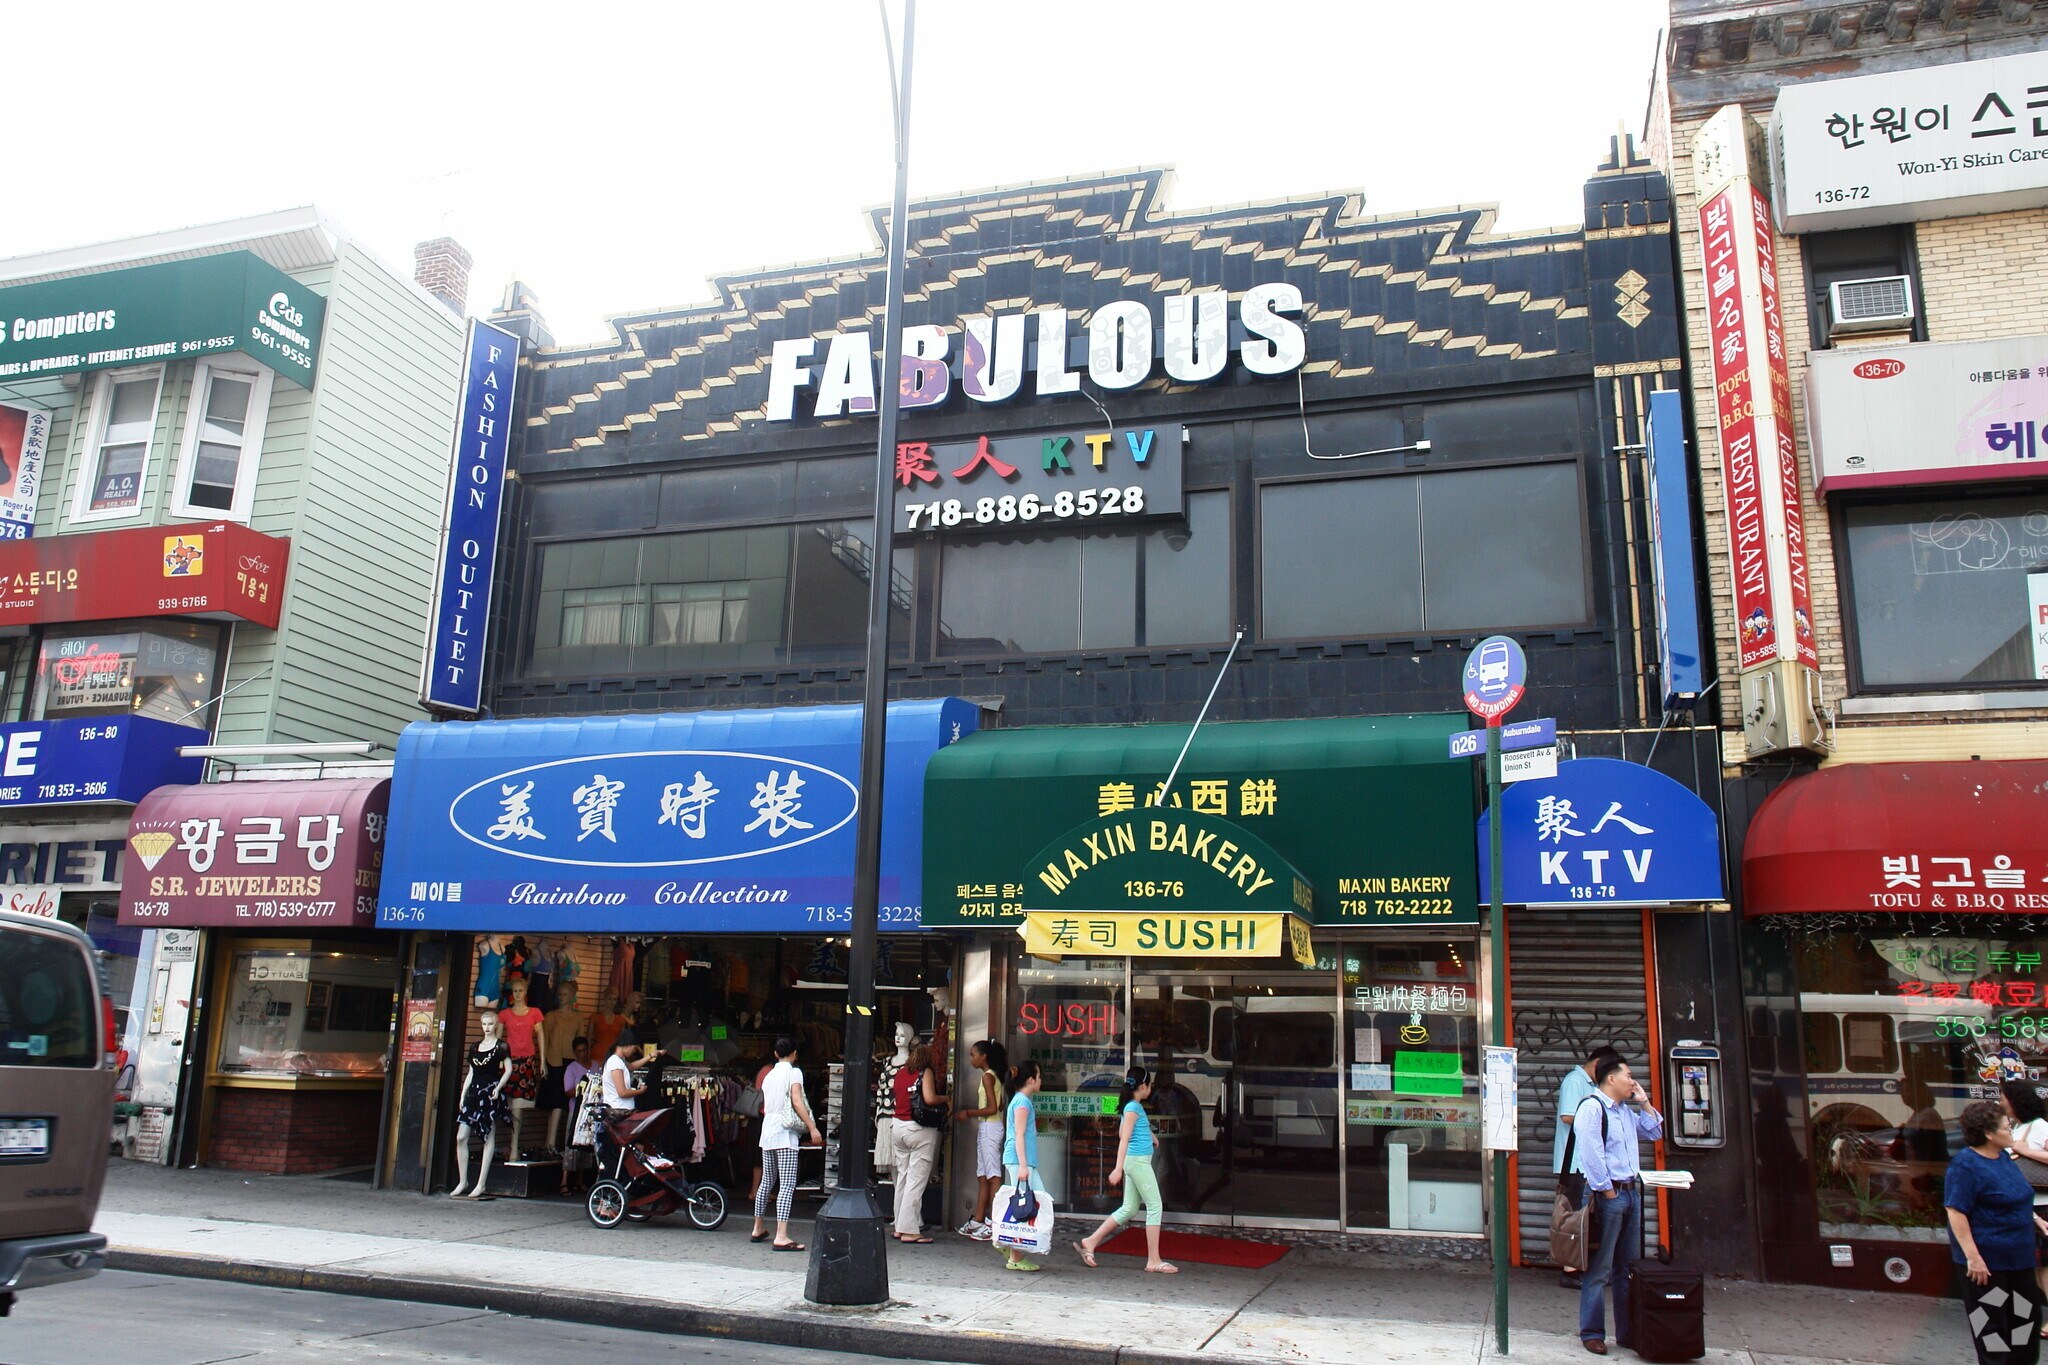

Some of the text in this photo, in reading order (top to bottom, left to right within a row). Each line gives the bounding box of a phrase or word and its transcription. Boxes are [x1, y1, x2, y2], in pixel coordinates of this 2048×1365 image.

[1825, 104, 1949, 150] 한원이
[1898, 147, 2048, 176] Won-Yi Skin Care
[1815, 186, 1870, 204] 136-72
[13, 309, 116, 342] Computers
[259, 310, 310, 350] Computers
[22, 362, 29, 373] &
[30, 354, 79, 372] UPGRADES
[88, 347, 134, 365] INTERNET
[135, 341, 177, 359] SERVICE
[766, 282, 1306, 422] FABULOUS
[1858, 361, 1901, 378] 136-70
[1970, 367, 2031, 384] 아름다움을
[1718, 366, 1750, 400] TOFU
[1731, 392, 1741, 406] &
[469, 345, 501, 511] FASHION
[104, 489, 132, 499] REALTY
[25, 503, 33, 512] Lo
[905, 485, 1144, 530] 718-886-8528
[1729, 431, 1766, 598] RESTAURANT
[1778, 430, 1807, 598] RESTAURANT
[239, 555, 269, 574] Fox
[237, 571, 269, 604] 미용실
[5, 600, 34, 609] STUDIO
[158, 596, 207, 610] 939-6766
[447, 539, 480, 686] OUTLET
[61, 640, 86, 656] 헤어
[1468, 689, 1519, 715] NO STANDING
[1503, 724, 1542, 738] Auburndale
[1452, 734, 1477, 756] Q26
[1504, 748, 1552, 762] Roosevelt Av &
[1504, 761, 1531, 772] Union St
[38, 785, 55, 798] 718
[487, 769, 814, 843] 美寶時裝
[1534, 795, 1654, 845] 聚人
[177, 814, 344, 873] 황금당
[1039, 822, 1137, 896] MAXIN
[1150, 820, 1275, 897] BAKERY
[1540, 848, 1653, 885] KTV
[150, 875, 321, 897] S.R. JEWELERS
[410, 882, 462, 903] 메이블
[508, 881, 791, 906] Rainbow Collection
[1124, 880, 1184, 898] 136-76
[1339, 876, 1452, 894] MAXIN BAKERY
[133, 902, 169, 917] 136-78
[235, 905, 251, 917] TEL.
[960, 902, 995, 918] 4가지
[1340, 899, 1453, 915] 718 762-2222
[1870, 893, 1921, 908] TOFU
[1931, 893, 1947, 908] &
[1956, 892, 2005, 910] B.B.Q
[383, 906, 425, 923] 136-76
[1051, 918, 1118, 949] 寿司
[1137, 918, 1256, 951] SUSHI
[1897, 980, 2048, 1008] 名家嫩豆
[1020, 1003, 1117, 1036] SUSHI
[1033, 1095, 1056, 1103] BUFFET
